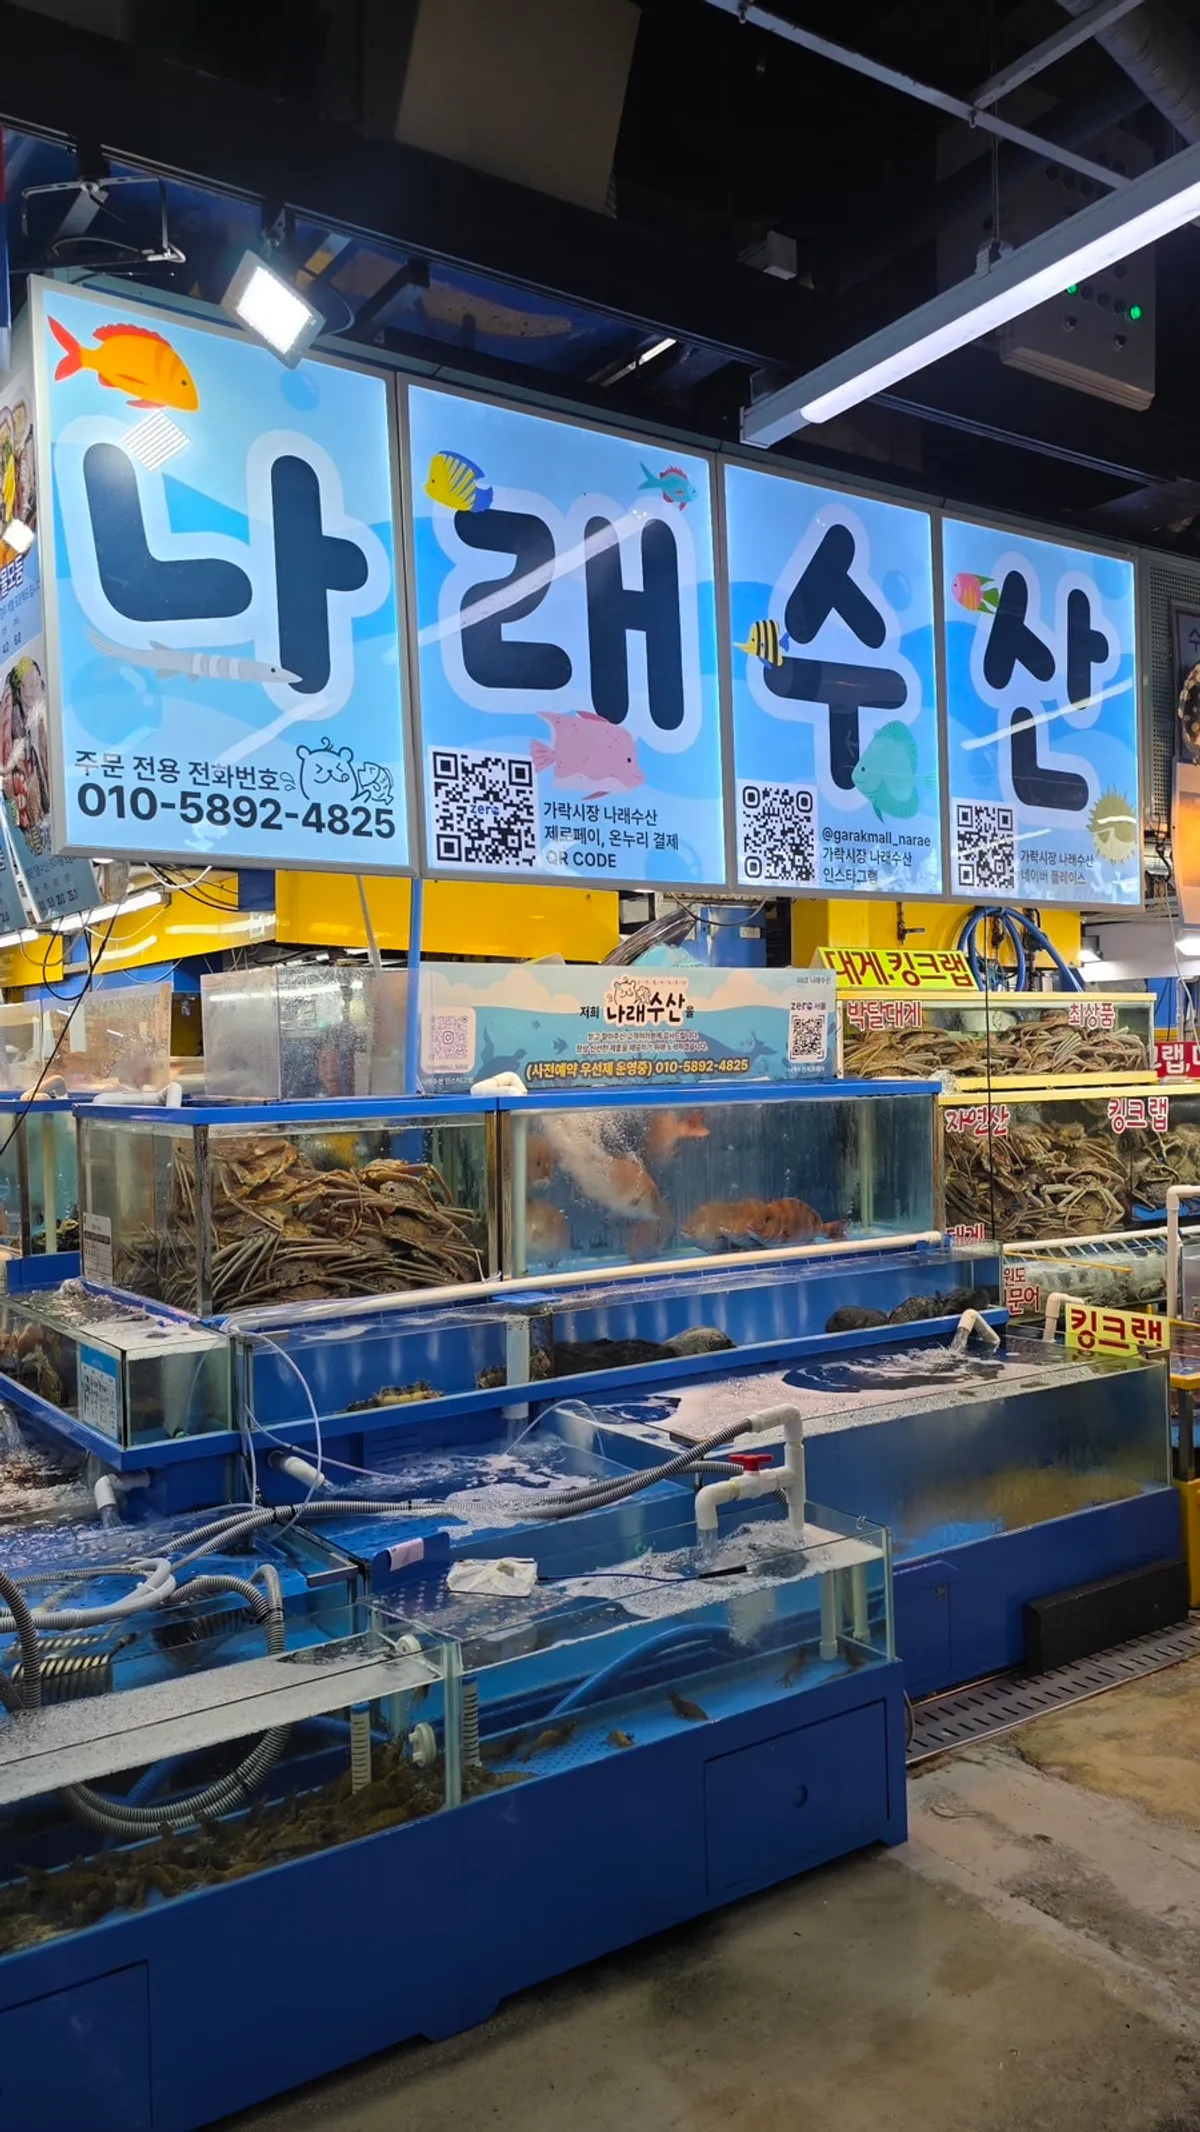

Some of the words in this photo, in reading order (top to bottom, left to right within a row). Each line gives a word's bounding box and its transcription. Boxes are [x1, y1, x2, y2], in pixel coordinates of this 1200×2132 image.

[75, 751, 125, 779] 주문
[133, 755, 180, 783] 전용
[188, 761, 280, 791] 전화번호
[77, 782, 396, 839] 010-5892-4825
[543, 802, 600, 823] 가락시장
[604, 806, 658, 827] 나래수산
[544, 825, 606, 848] 제로페이,
[609, 830, 649, 849] 온누리
[653, 832, 679, 851] 결제
[822, 827, 931, 848] @garakmall_narae
[546, 851, 568, 867] QR
[573, 851, 617, 868] CODE
[823, 846, 867, 864] 가락시장
[869, 848, 912, 867] 나래수산
[1020, 849, 1056, 866] 가락시장
[1059, 850, 1094, 867] 나래수산
[823, 867, 878, 884] 인스타그램
[1021, 867, 1049, 882] 네이버
[1051, 869, 1087, 885] 플레이스
[579, 1005, 600, 1019] 저희
[606, 991, 686, 1023] 나래수산
[846, 1001, 923, 1032] 박달대게
[1068, 1002, 1116, 1029] 최상품
[526, 1063, 577, 1080] (사전예약
[580, 1062, 614, 1077] 우선제
[615, 1061, 652, 1077] 운영중)
[655, 1058, 749, 1074] 010-5892-4825
[945, 1105, 1010, 1136] 자연산
